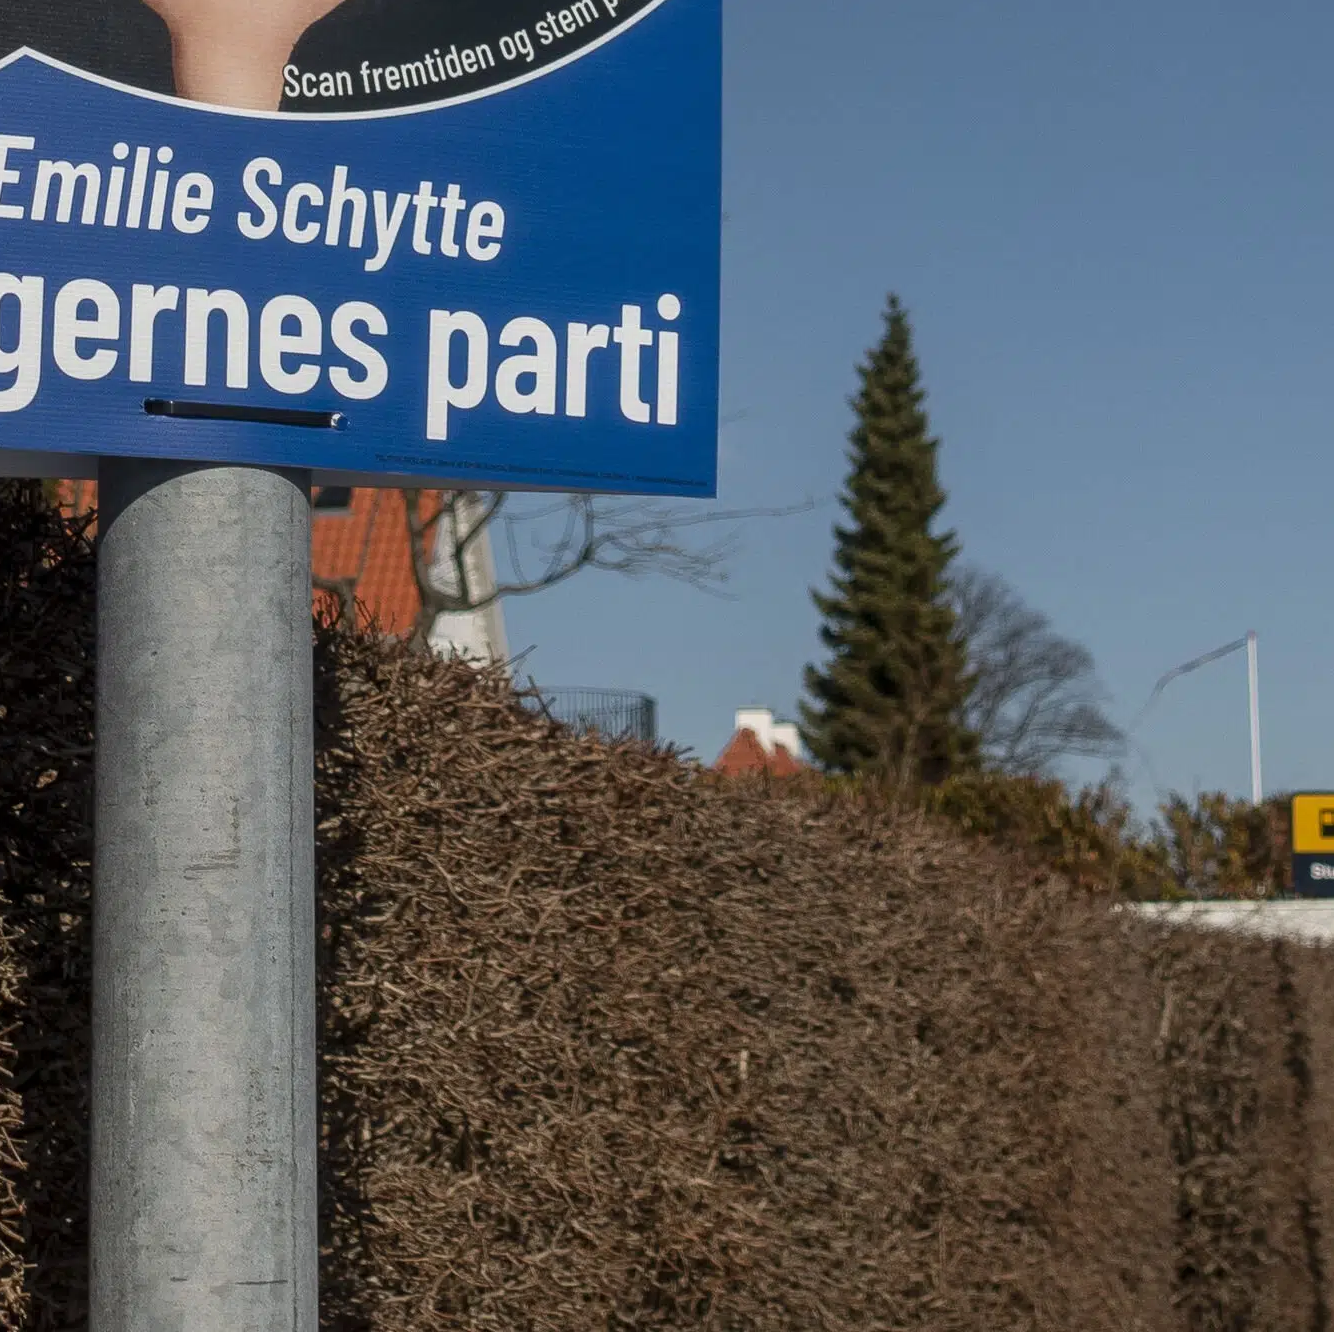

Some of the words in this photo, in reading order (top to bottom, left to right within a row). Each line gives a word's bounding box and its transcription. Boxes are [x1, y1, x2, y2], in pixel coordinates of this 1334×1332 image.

[283, 63, 354, 99] Scan
[359, 43, 496, 94] fremtiden
[498, 28, 535, 63] og
[237, 156, 505, 272] Schytte
[426, 293, 681, 441] parti
